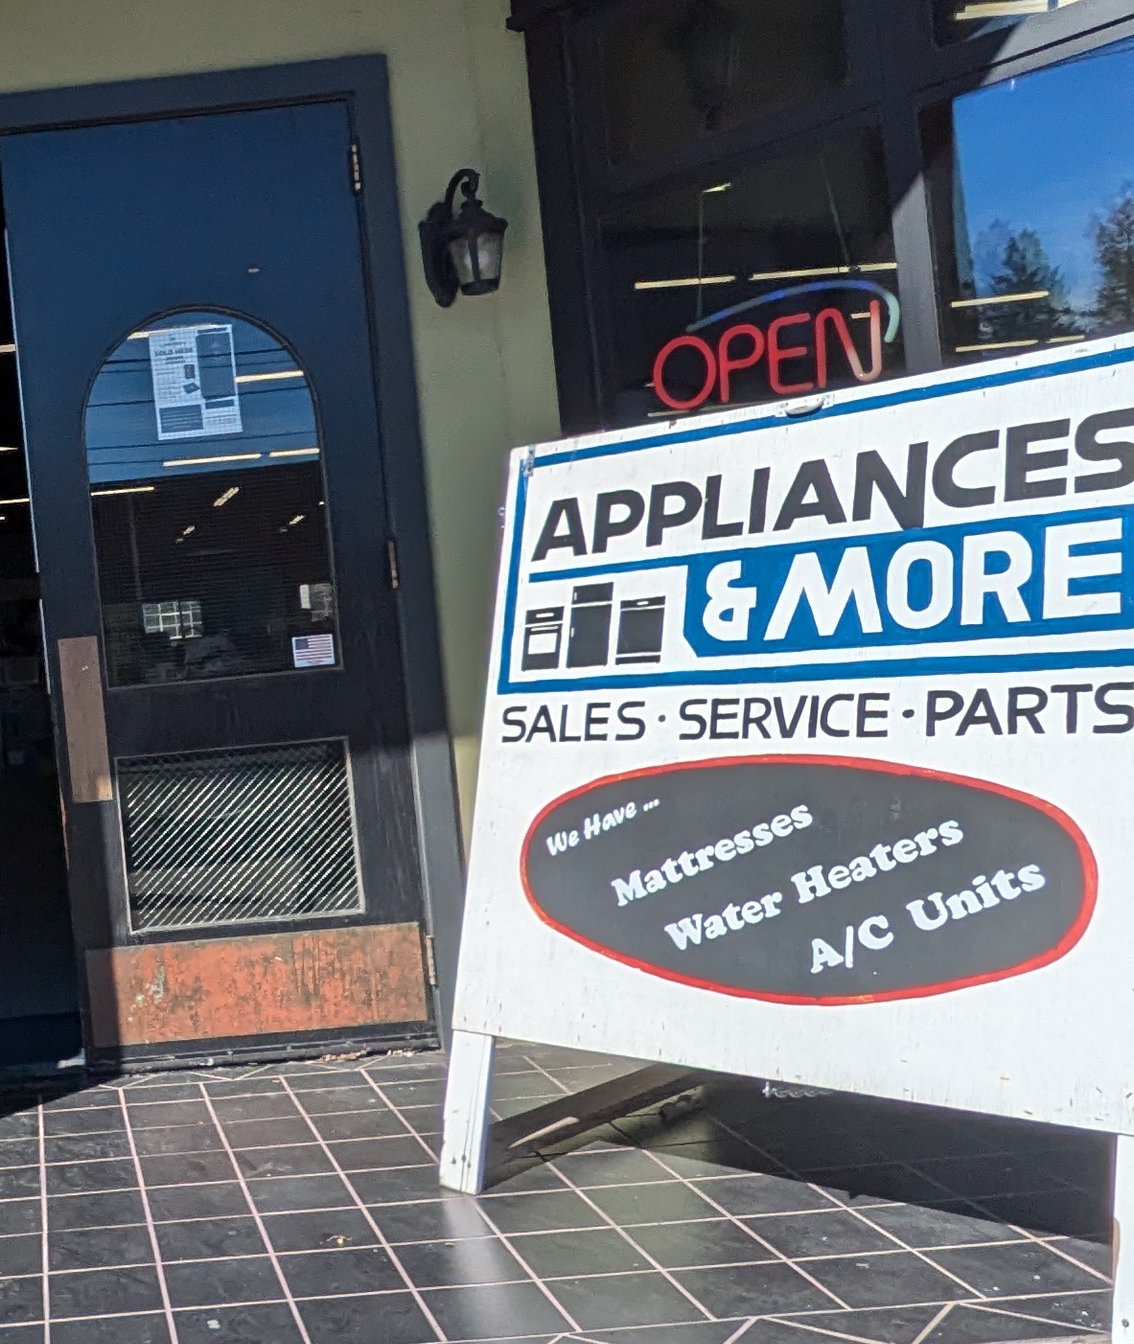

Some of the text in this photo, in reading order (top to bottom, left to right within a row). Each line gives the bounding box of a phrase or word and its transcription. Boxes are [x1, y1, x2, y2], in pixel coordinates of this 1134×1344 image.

[653, 300, 882, 410] OPEN
[531, 408, 1134, 562] APPLIANCES
[546, 827, 580, 856] We
[583, 801, 637, 840] Have
[611, 804, 813, 907] Mattresses
[665, 819, 964, 952] Water Heaters
[810, 863, 1046, 974] A/C Units
